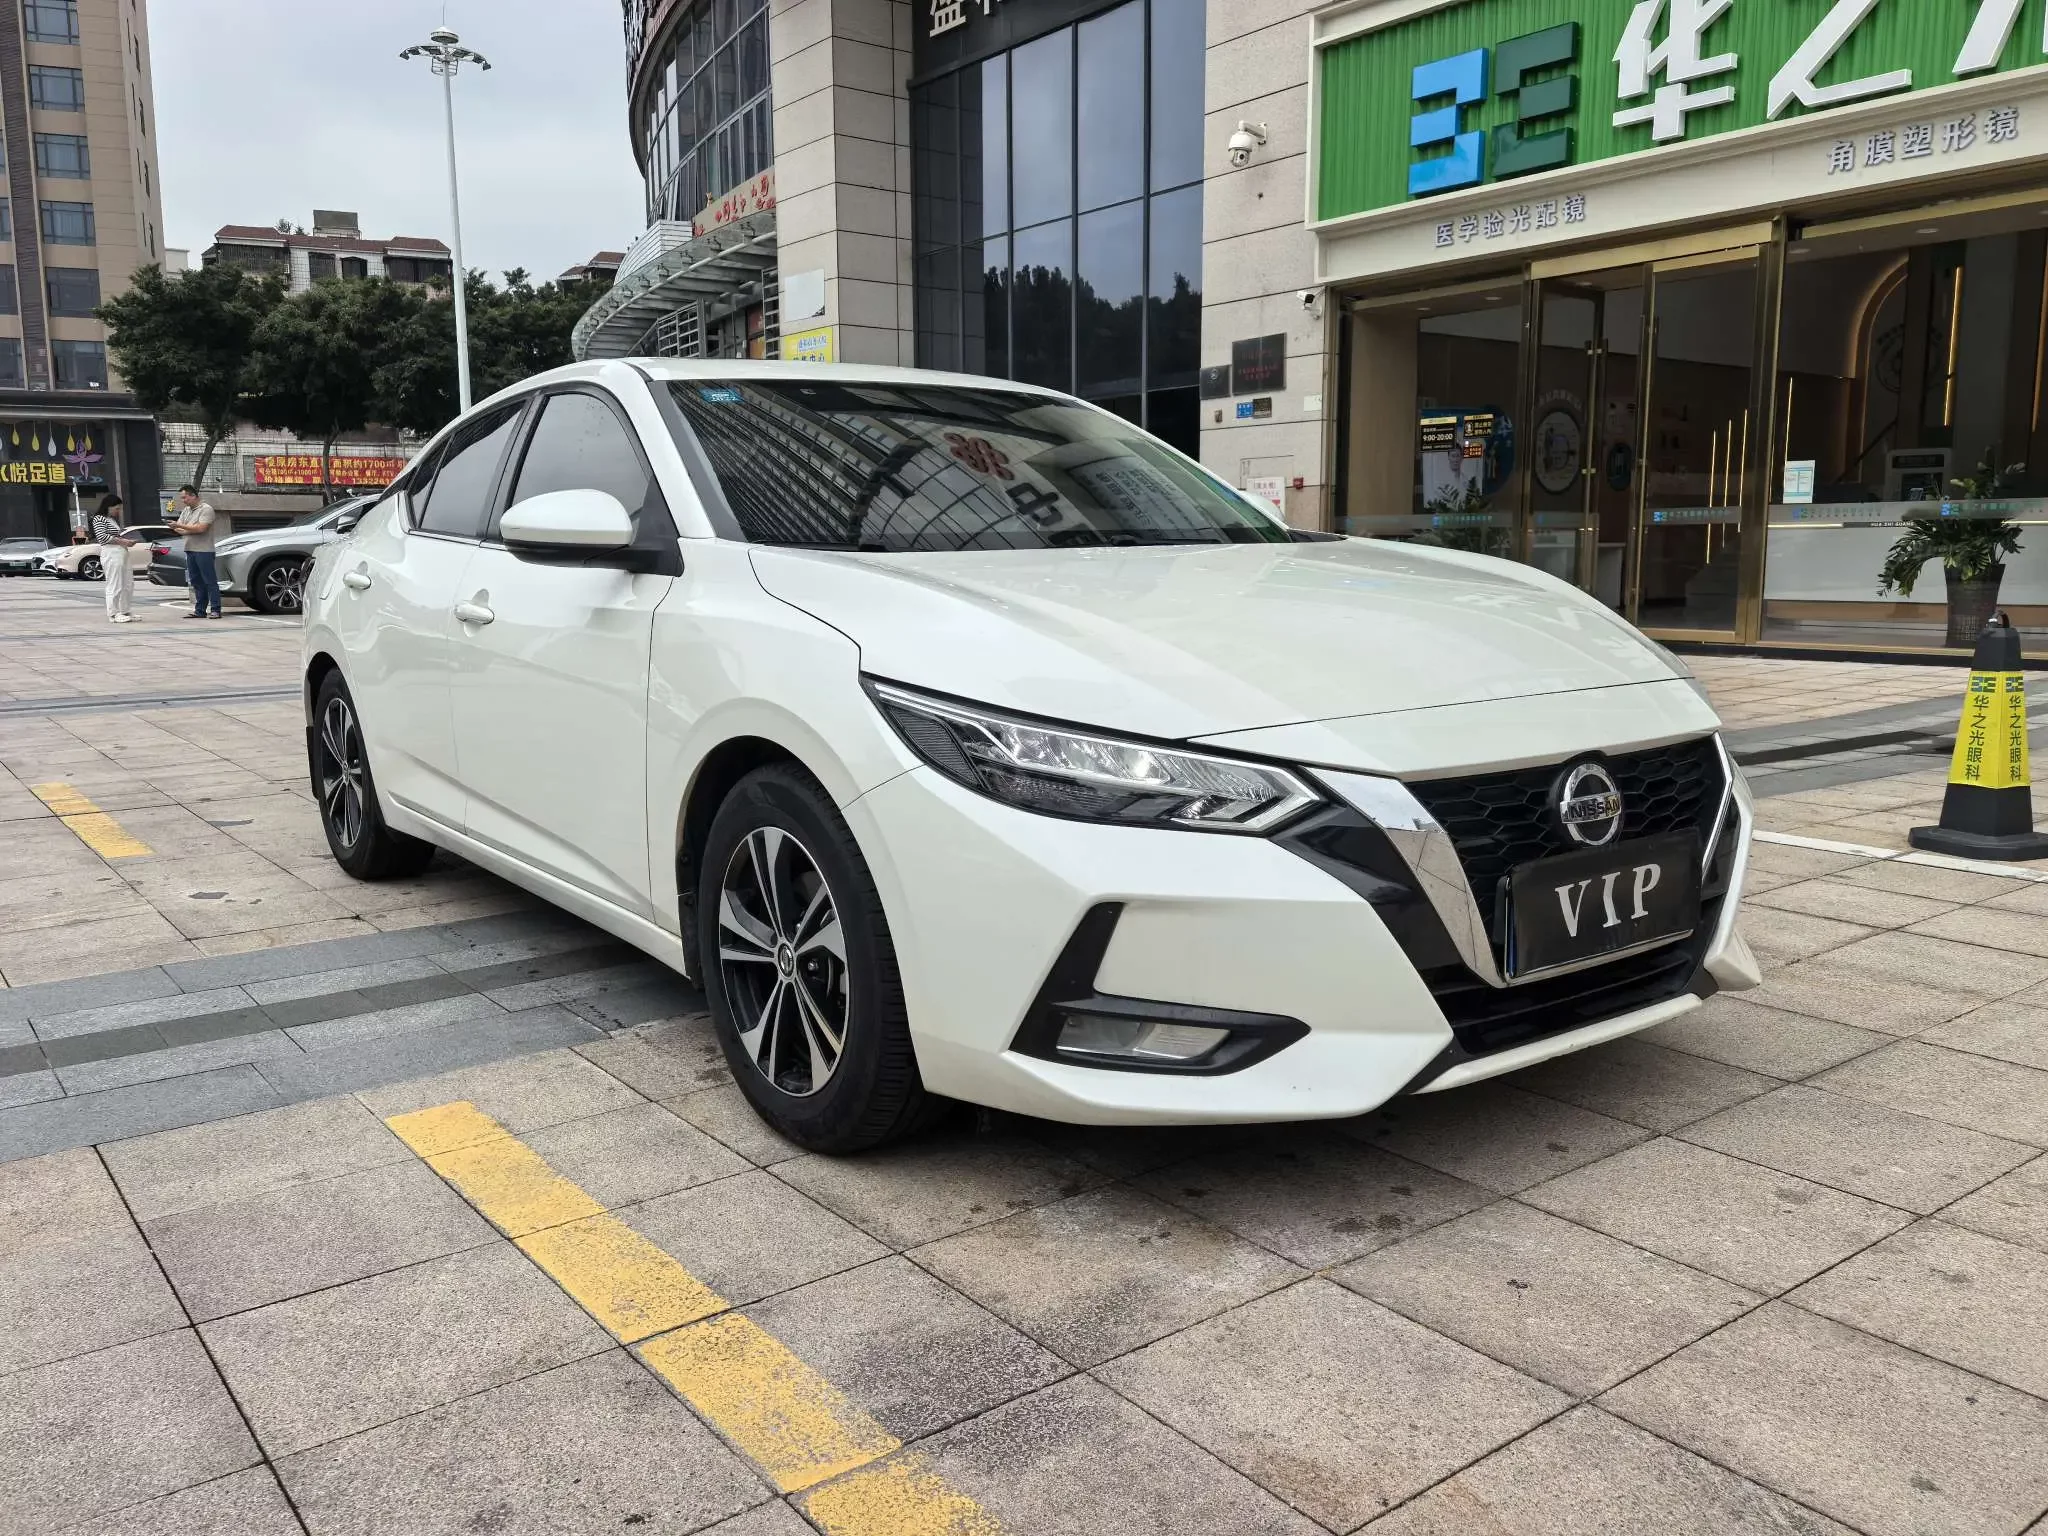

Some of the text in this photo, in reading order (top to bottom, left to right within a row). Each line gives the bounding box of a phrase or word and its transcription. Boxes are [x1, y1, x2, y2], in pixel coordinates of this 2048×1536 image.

[1827, 106, 2019, 175] 角膜塑形镜
[1434, 193, 1586, 248] 医学验光配镜
[1964, 694, 1990, 781] 华之光眼科
[2008, 694, 2022, 781] 华之光眼科
[1568, 797, 1620, 819] NISSAN
[1555, 863, 1661, 938] VIP
